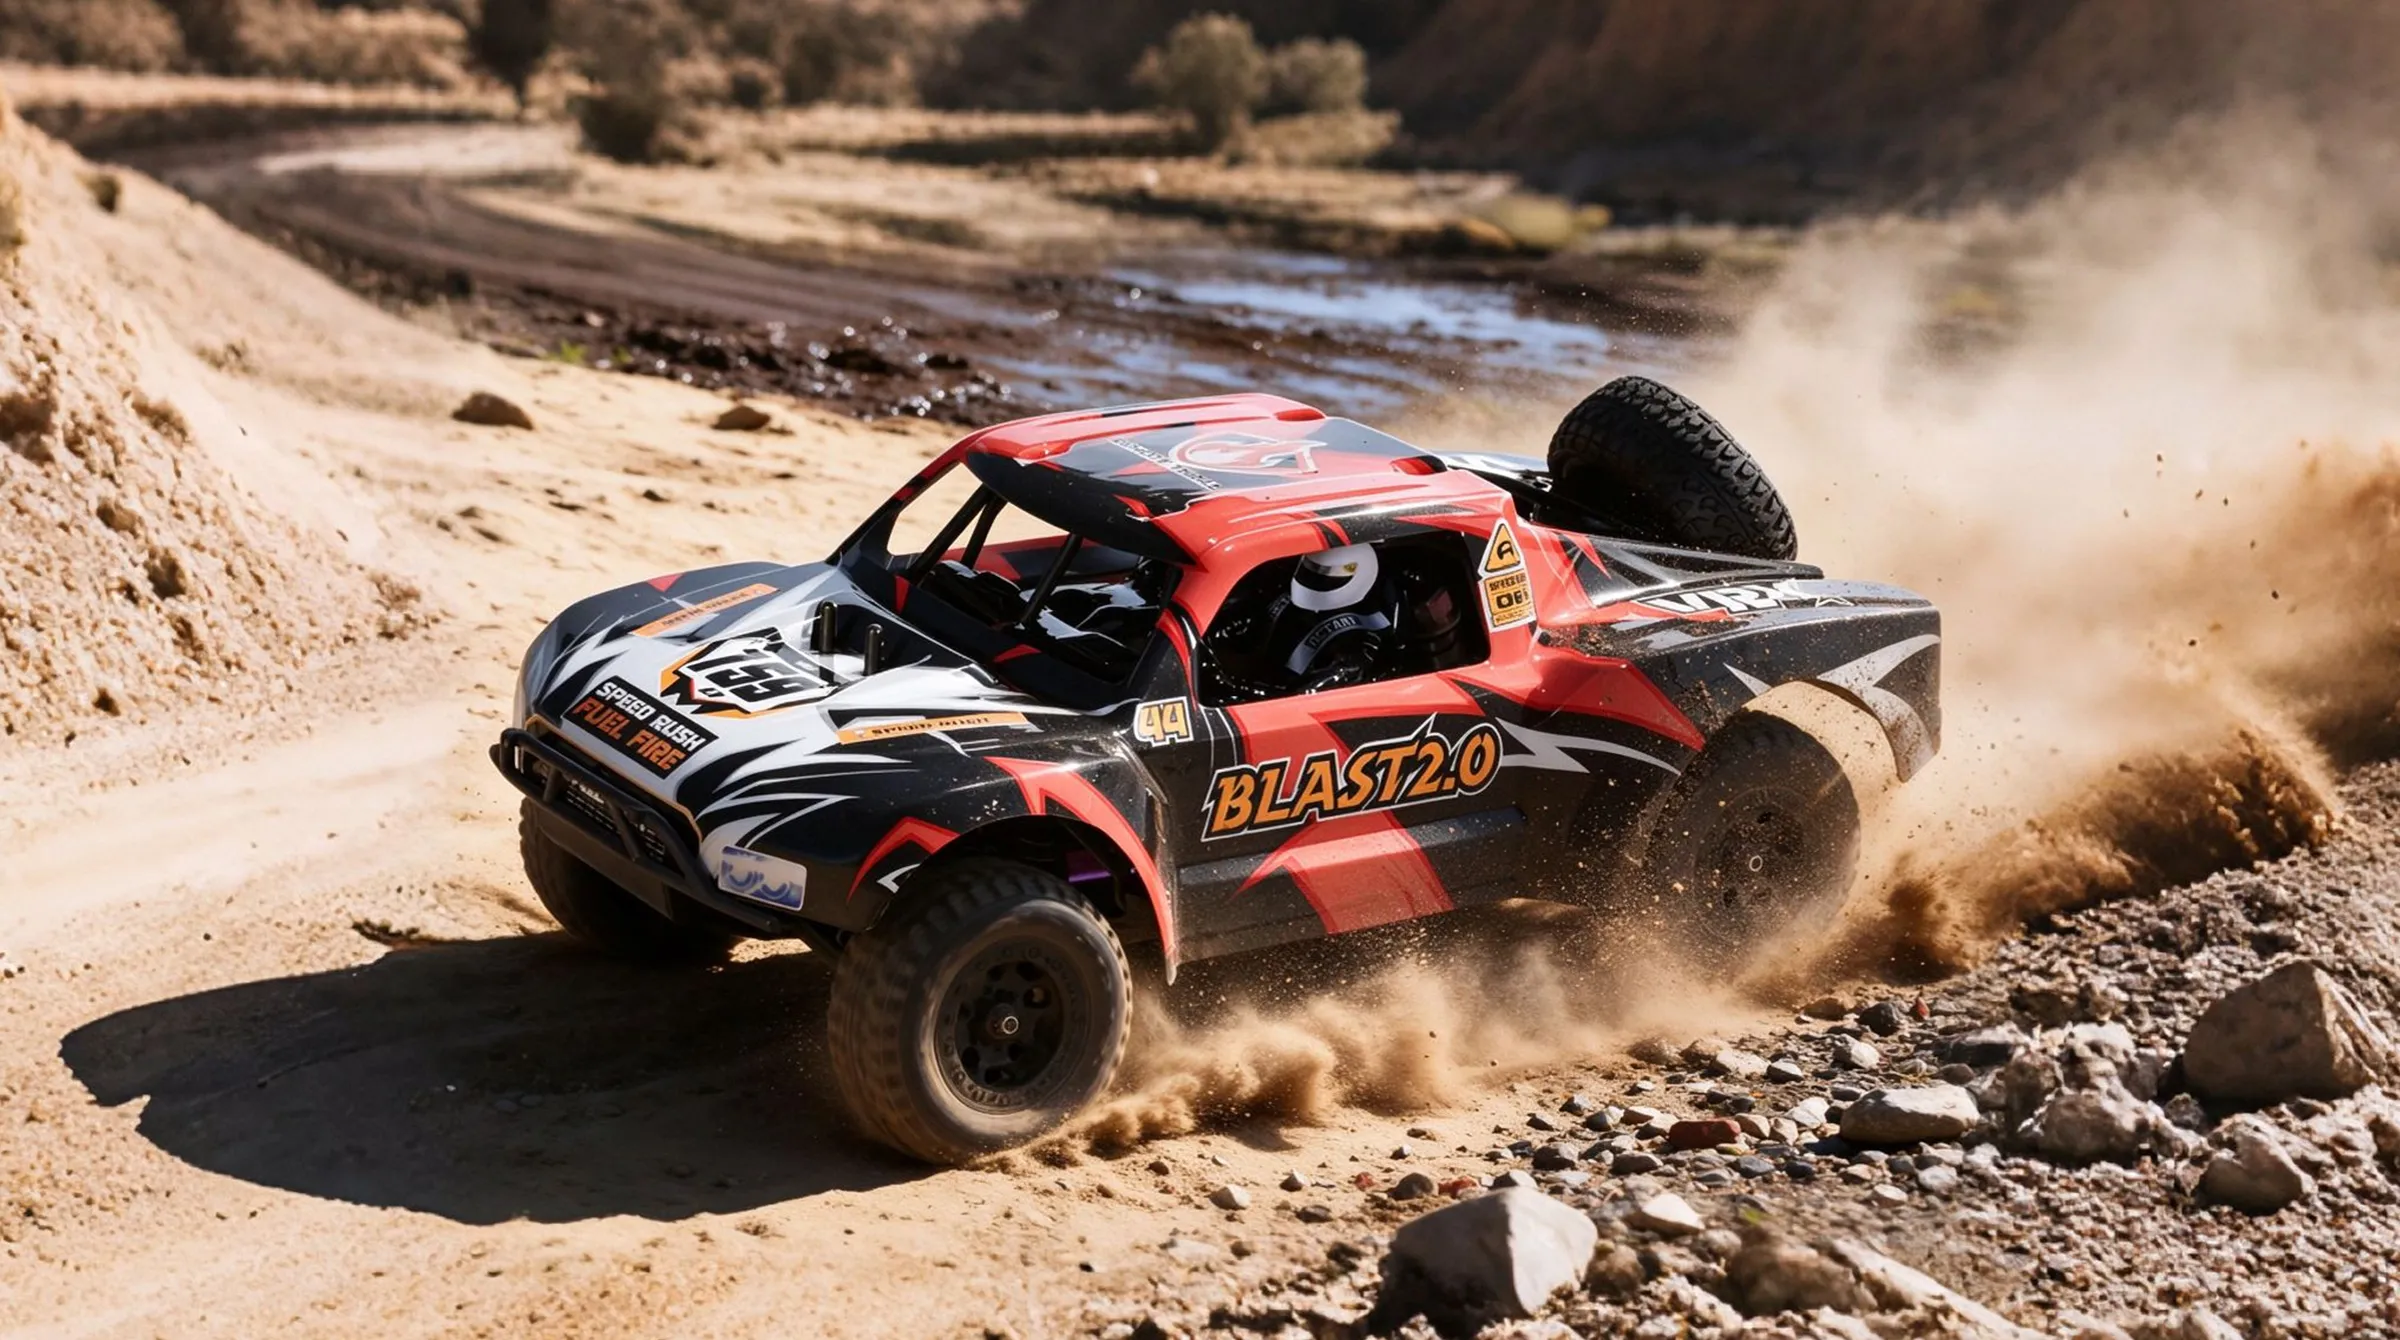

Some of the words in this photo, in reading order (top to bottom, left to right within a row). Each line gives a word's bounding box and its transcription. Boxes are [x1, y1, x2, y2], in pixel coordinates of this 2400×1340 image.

[572, 696, 631, 740] FUEL
[625, 729, 687, 770] FIRE
[595, 681, 656, 721] SPEED
[649, 714, 707, 752] RUSH
[1138, 701, 1189, 742] 44
